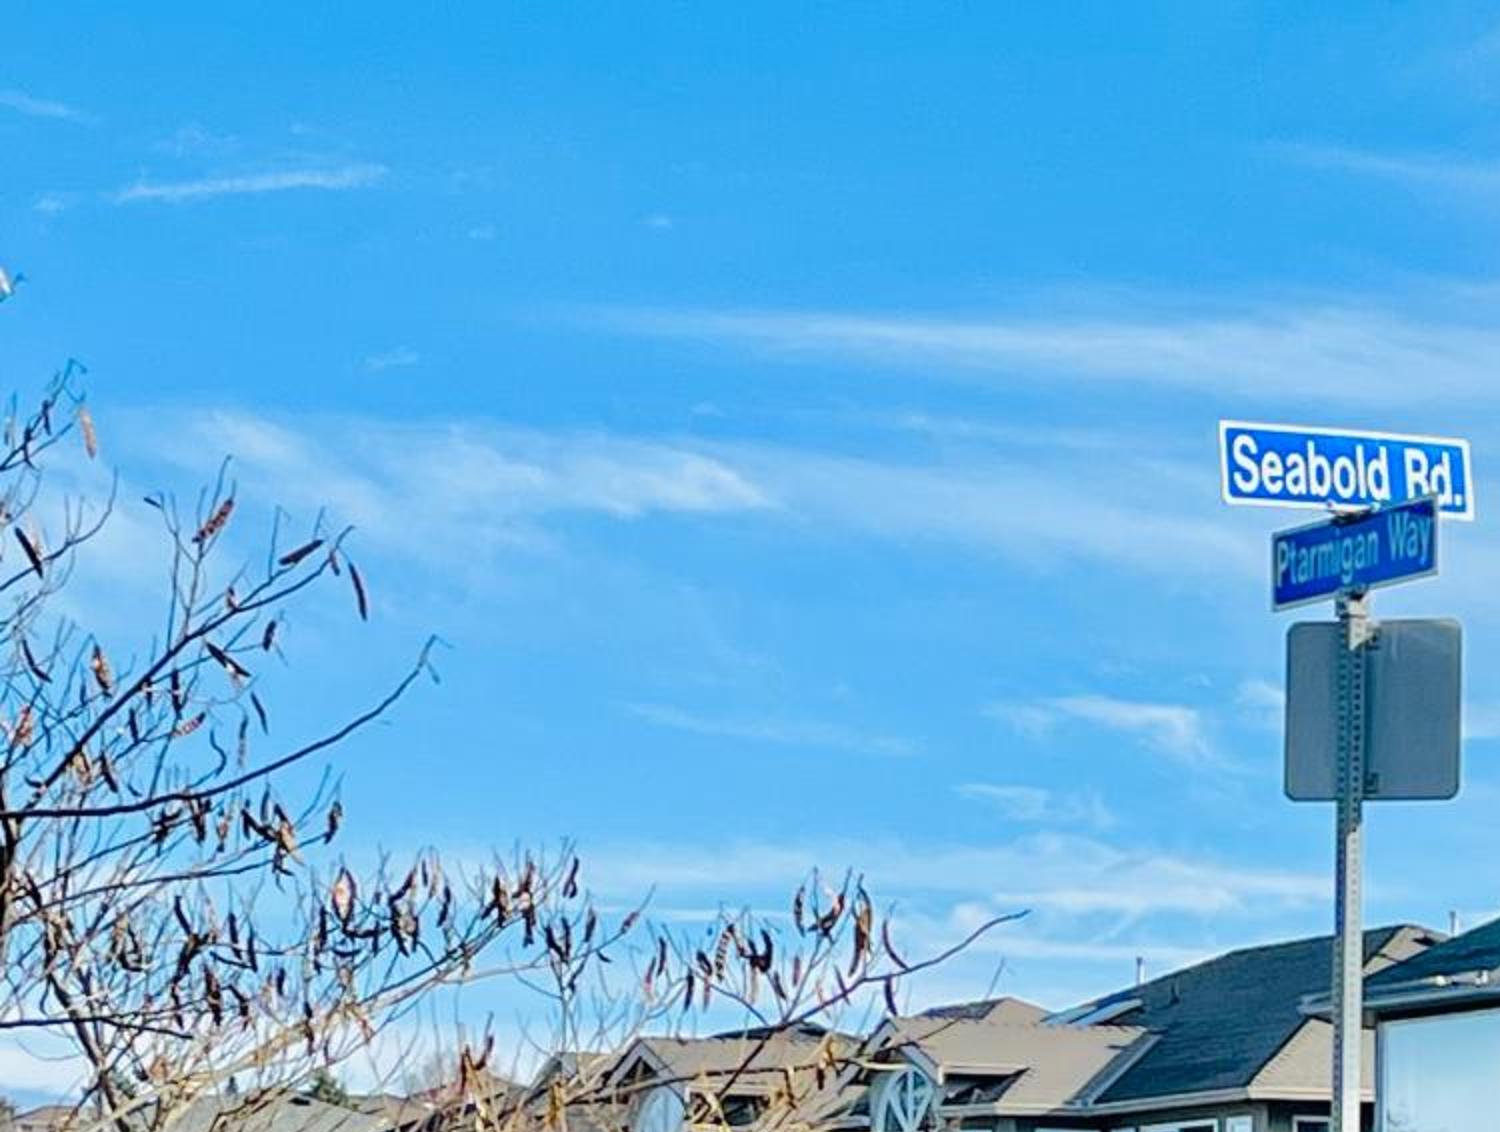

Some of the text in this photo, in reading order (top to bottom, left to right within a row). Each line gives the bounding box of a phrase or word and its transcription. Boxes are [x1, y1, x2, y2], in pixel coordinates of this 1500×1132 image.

[1232, 434, 1463, 507] Seabold Rd.
[1276, 509, 1435, 588] Ptarmigan Way
